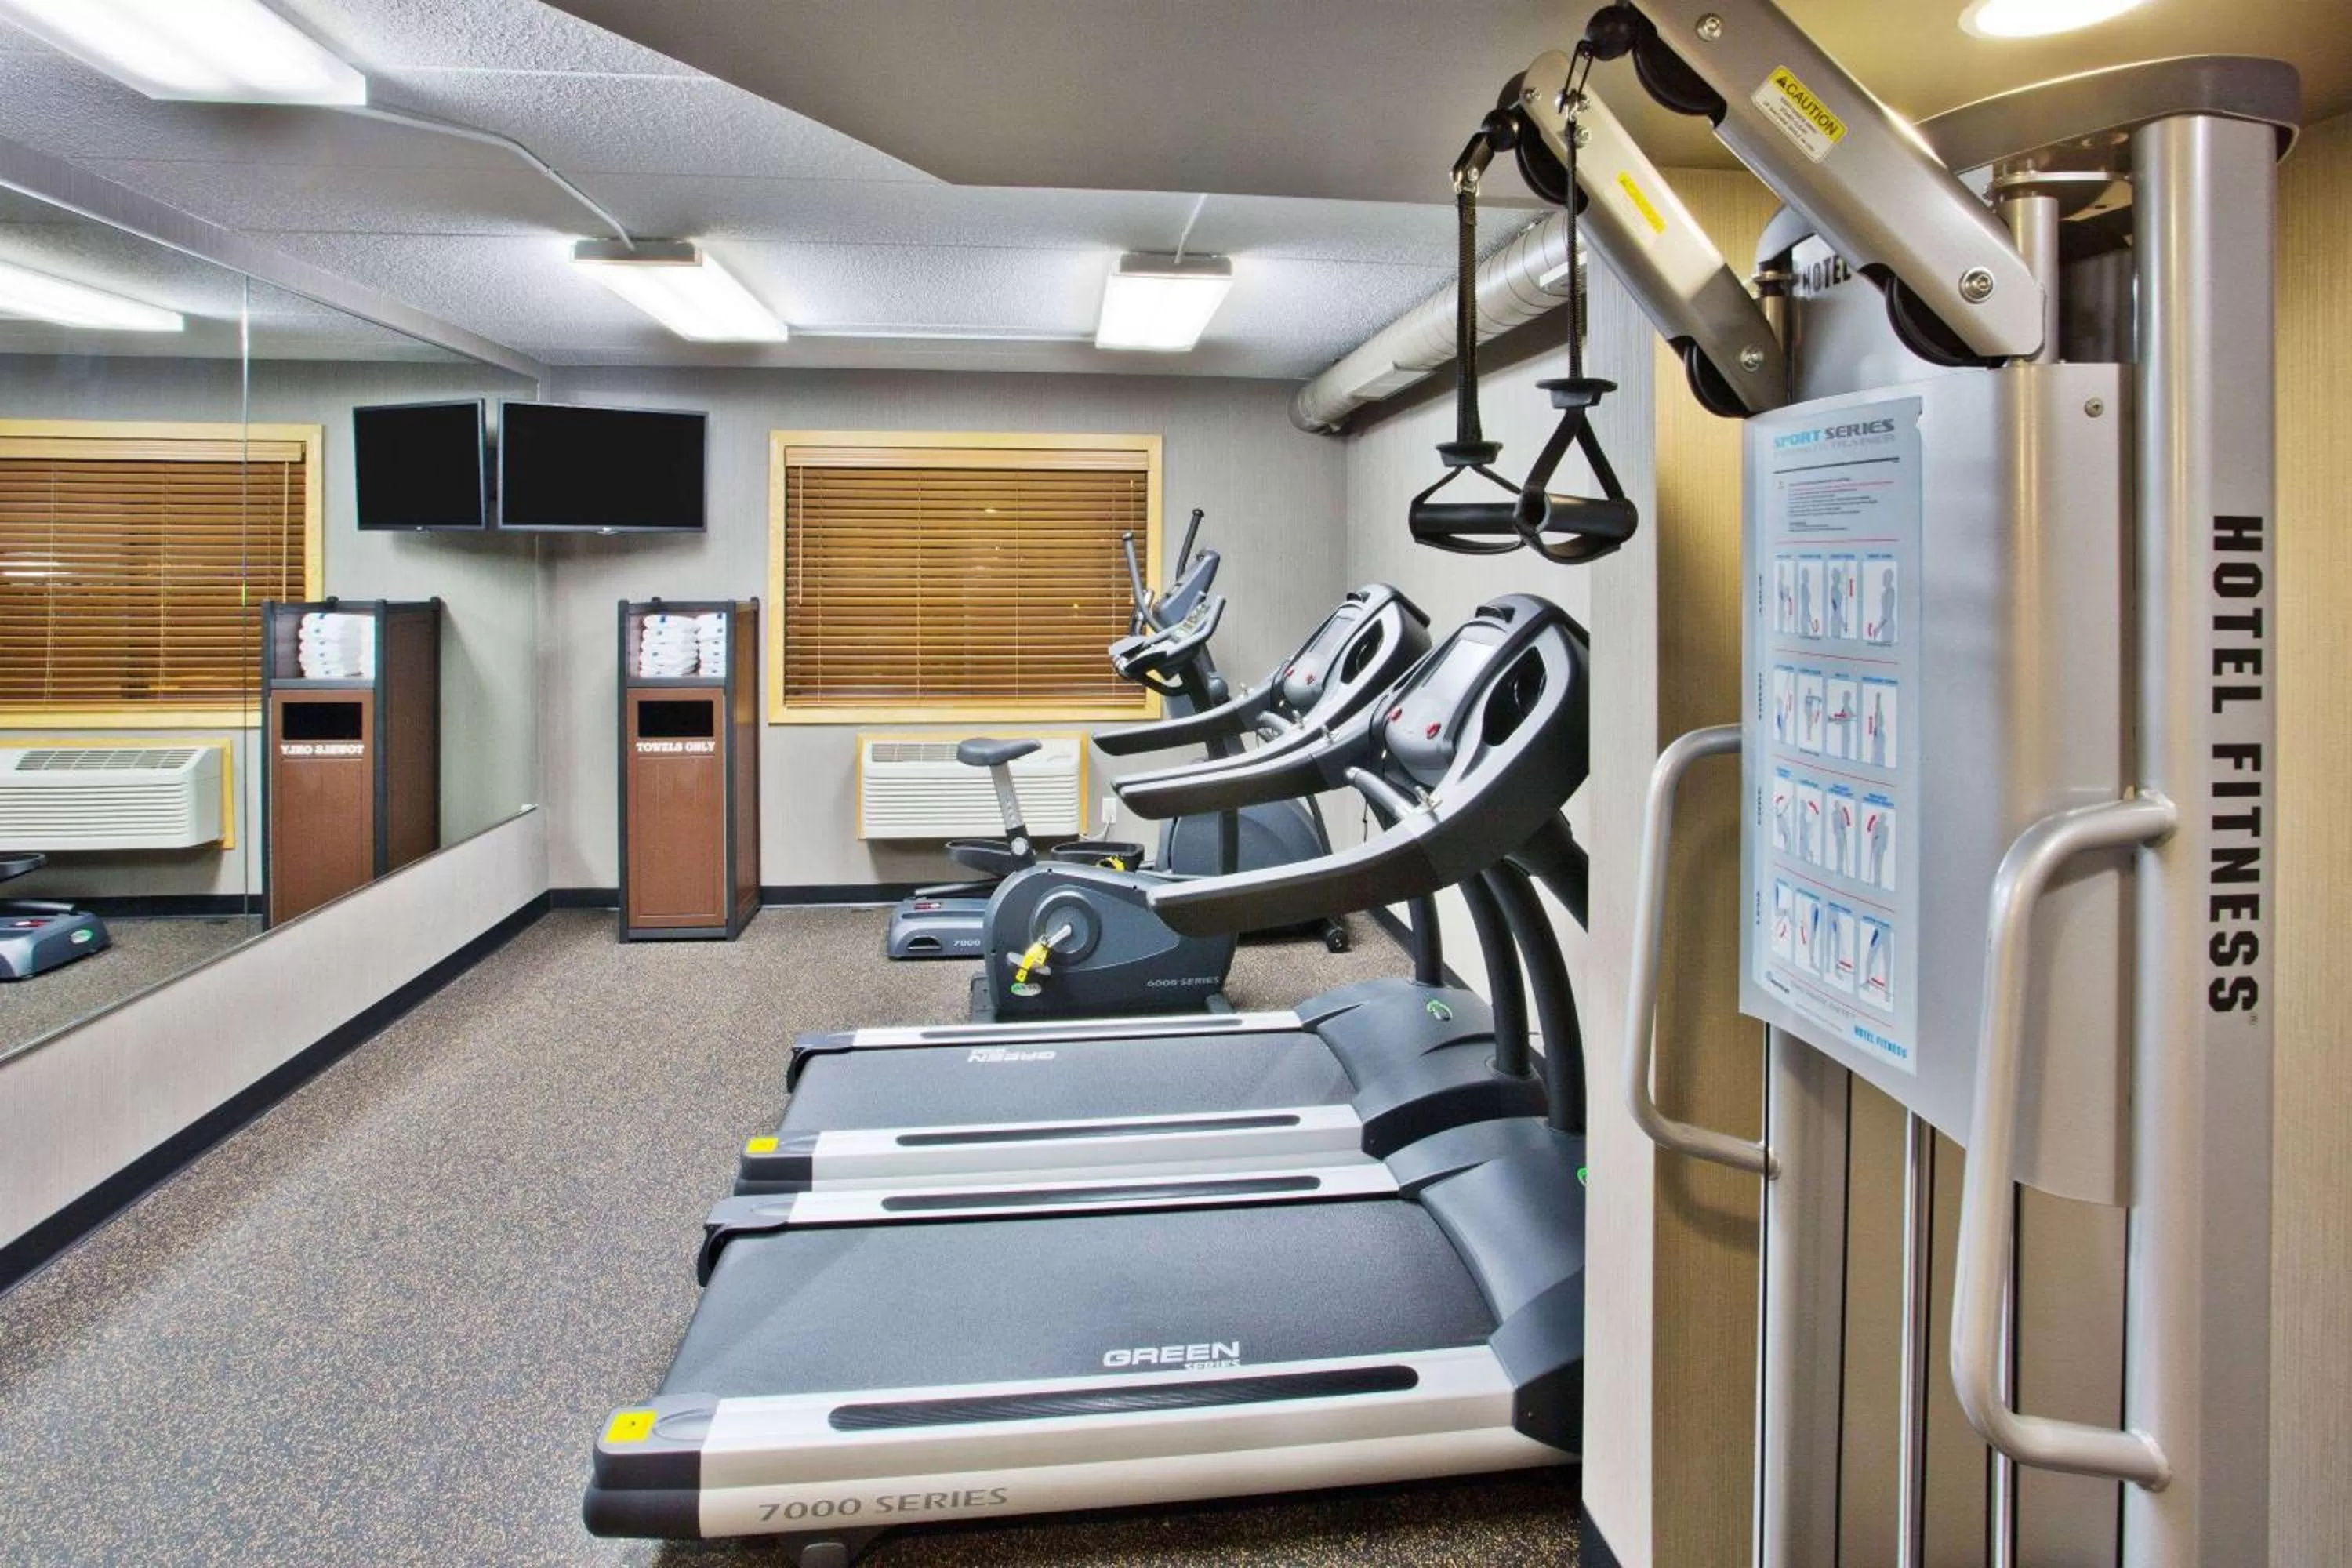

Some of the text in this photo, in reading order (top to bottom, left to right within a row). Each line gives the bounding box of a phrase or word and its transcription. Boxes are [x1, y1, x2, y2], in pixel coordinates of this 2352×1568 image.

[1785, 82, 1839, 136] CAUTION
[1773, 419, 1895, 448] SPORT SERIES
[636, 741, 715, 752] TOWELS ONLY
[2208, 515, 2263, 1012] HOTEL FITNESS
[1181, 976, 1220, 986] SERIES
[1103, 1341, 1240, 1367] GREEN
[758, 1487, 1008, 1522] 7000 SERIES
